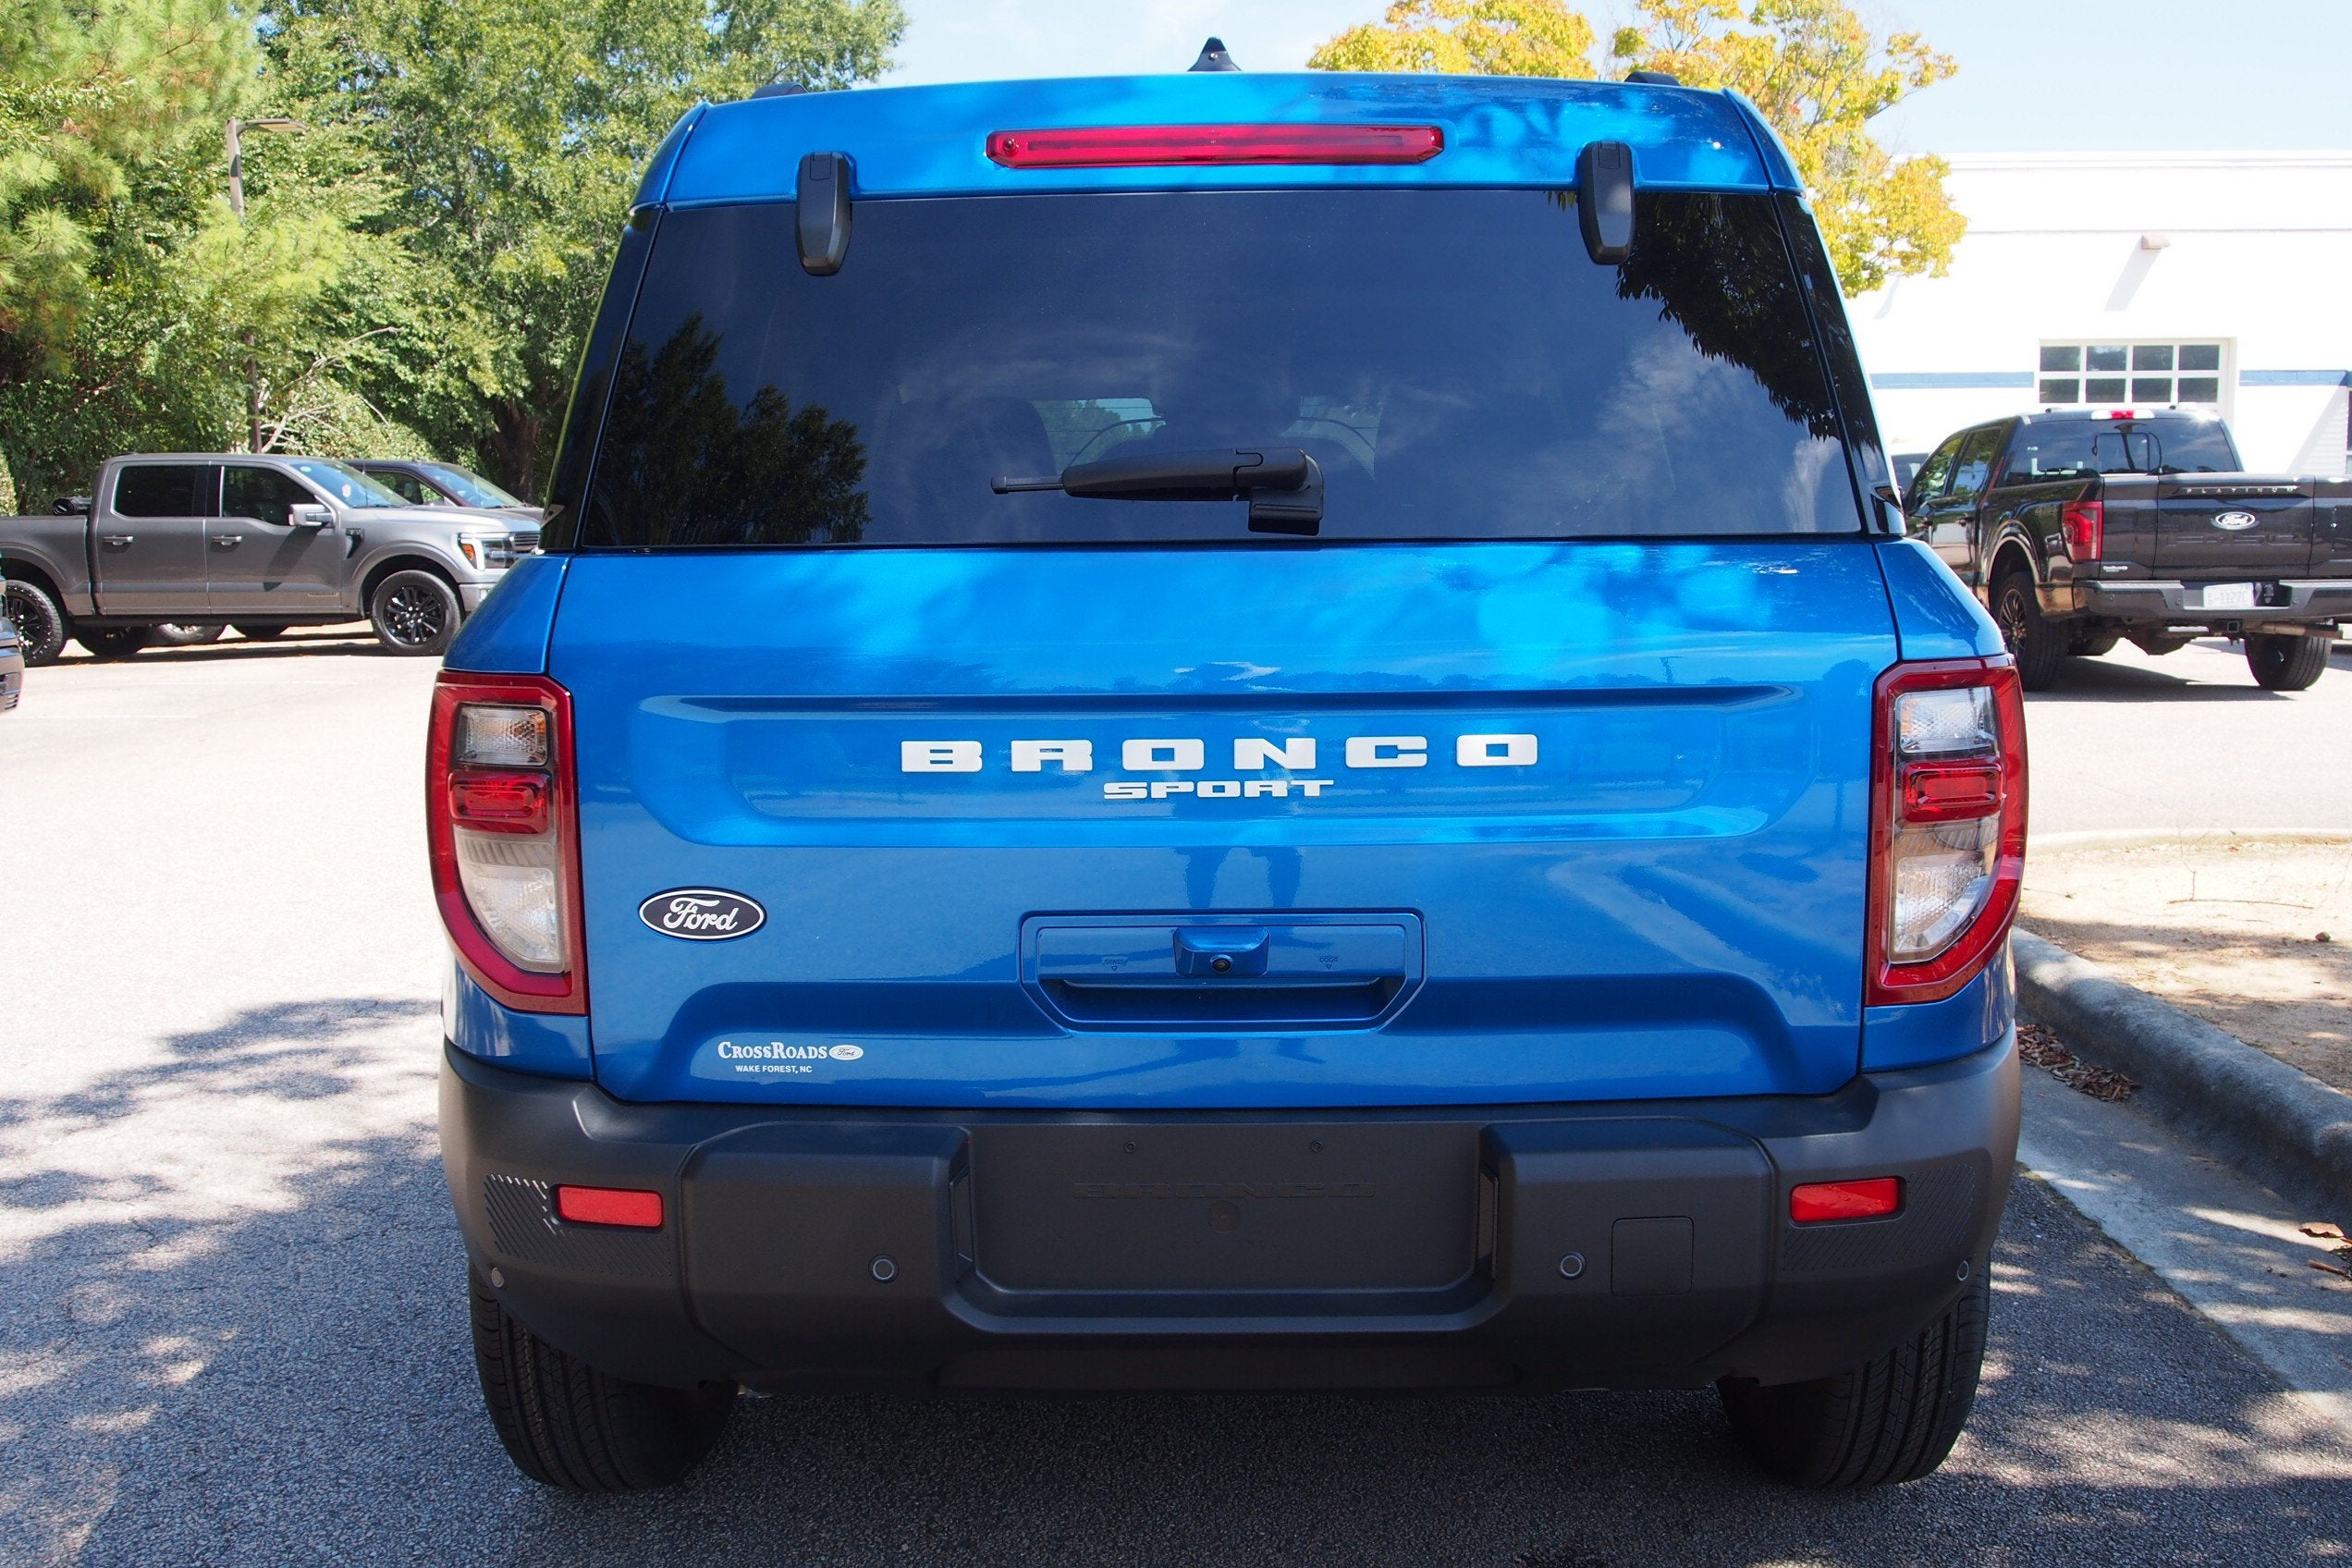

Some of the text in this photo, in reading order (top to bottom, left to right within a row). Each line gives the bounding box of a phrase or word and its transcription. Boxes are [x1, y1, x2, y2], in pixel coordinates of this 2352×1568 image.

[900, 734, 1537, 773] BRONCO
[1103, 779, 1334, 800] SPORT
[663, 897, 739, 931] Ford
[762, 1065, 798, 1074] FOREST,
[800, 1065, 813, 1073] NC
[1072, 1182, 1376, 1200] BRONCO
